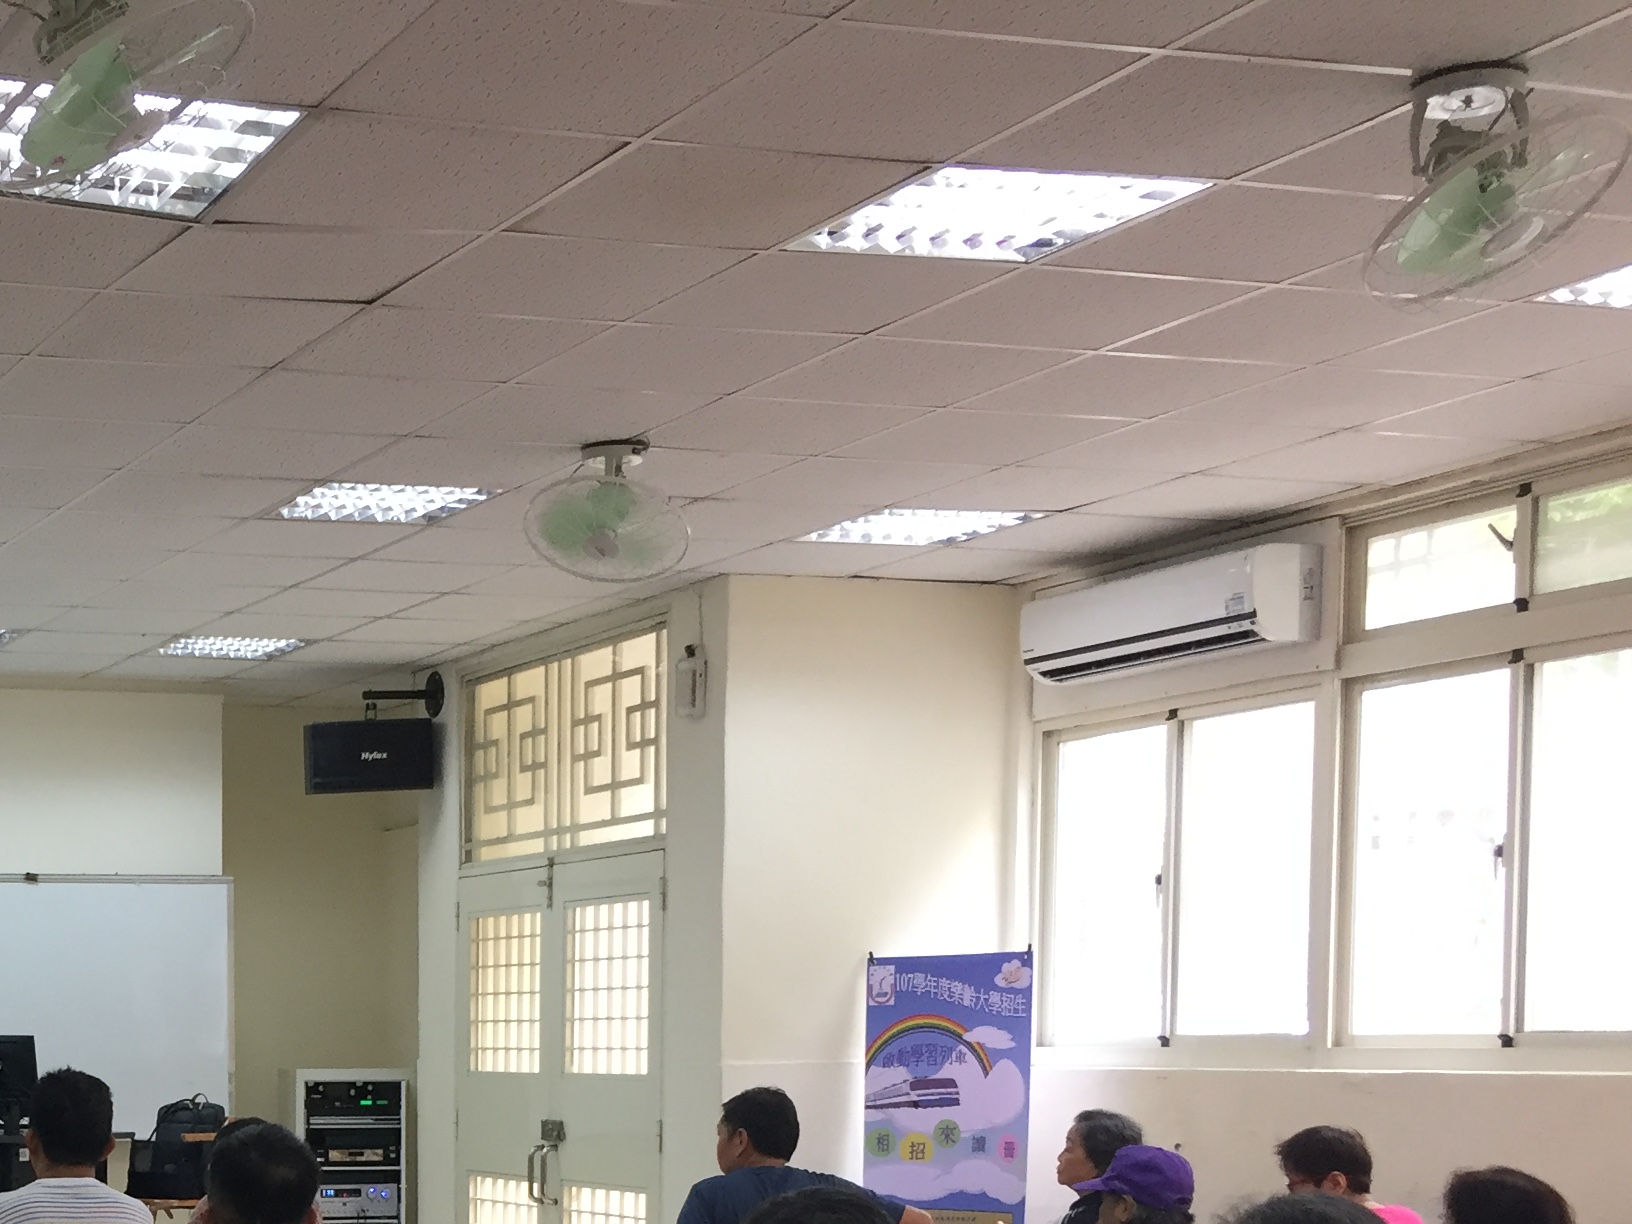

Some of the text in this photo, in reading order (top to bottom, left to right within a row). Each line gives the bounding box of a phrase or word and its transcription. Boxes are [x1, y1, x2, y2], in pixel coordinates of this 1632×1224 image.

[895, 972, 1027, 1017] 107學年度樂齡大學招生
